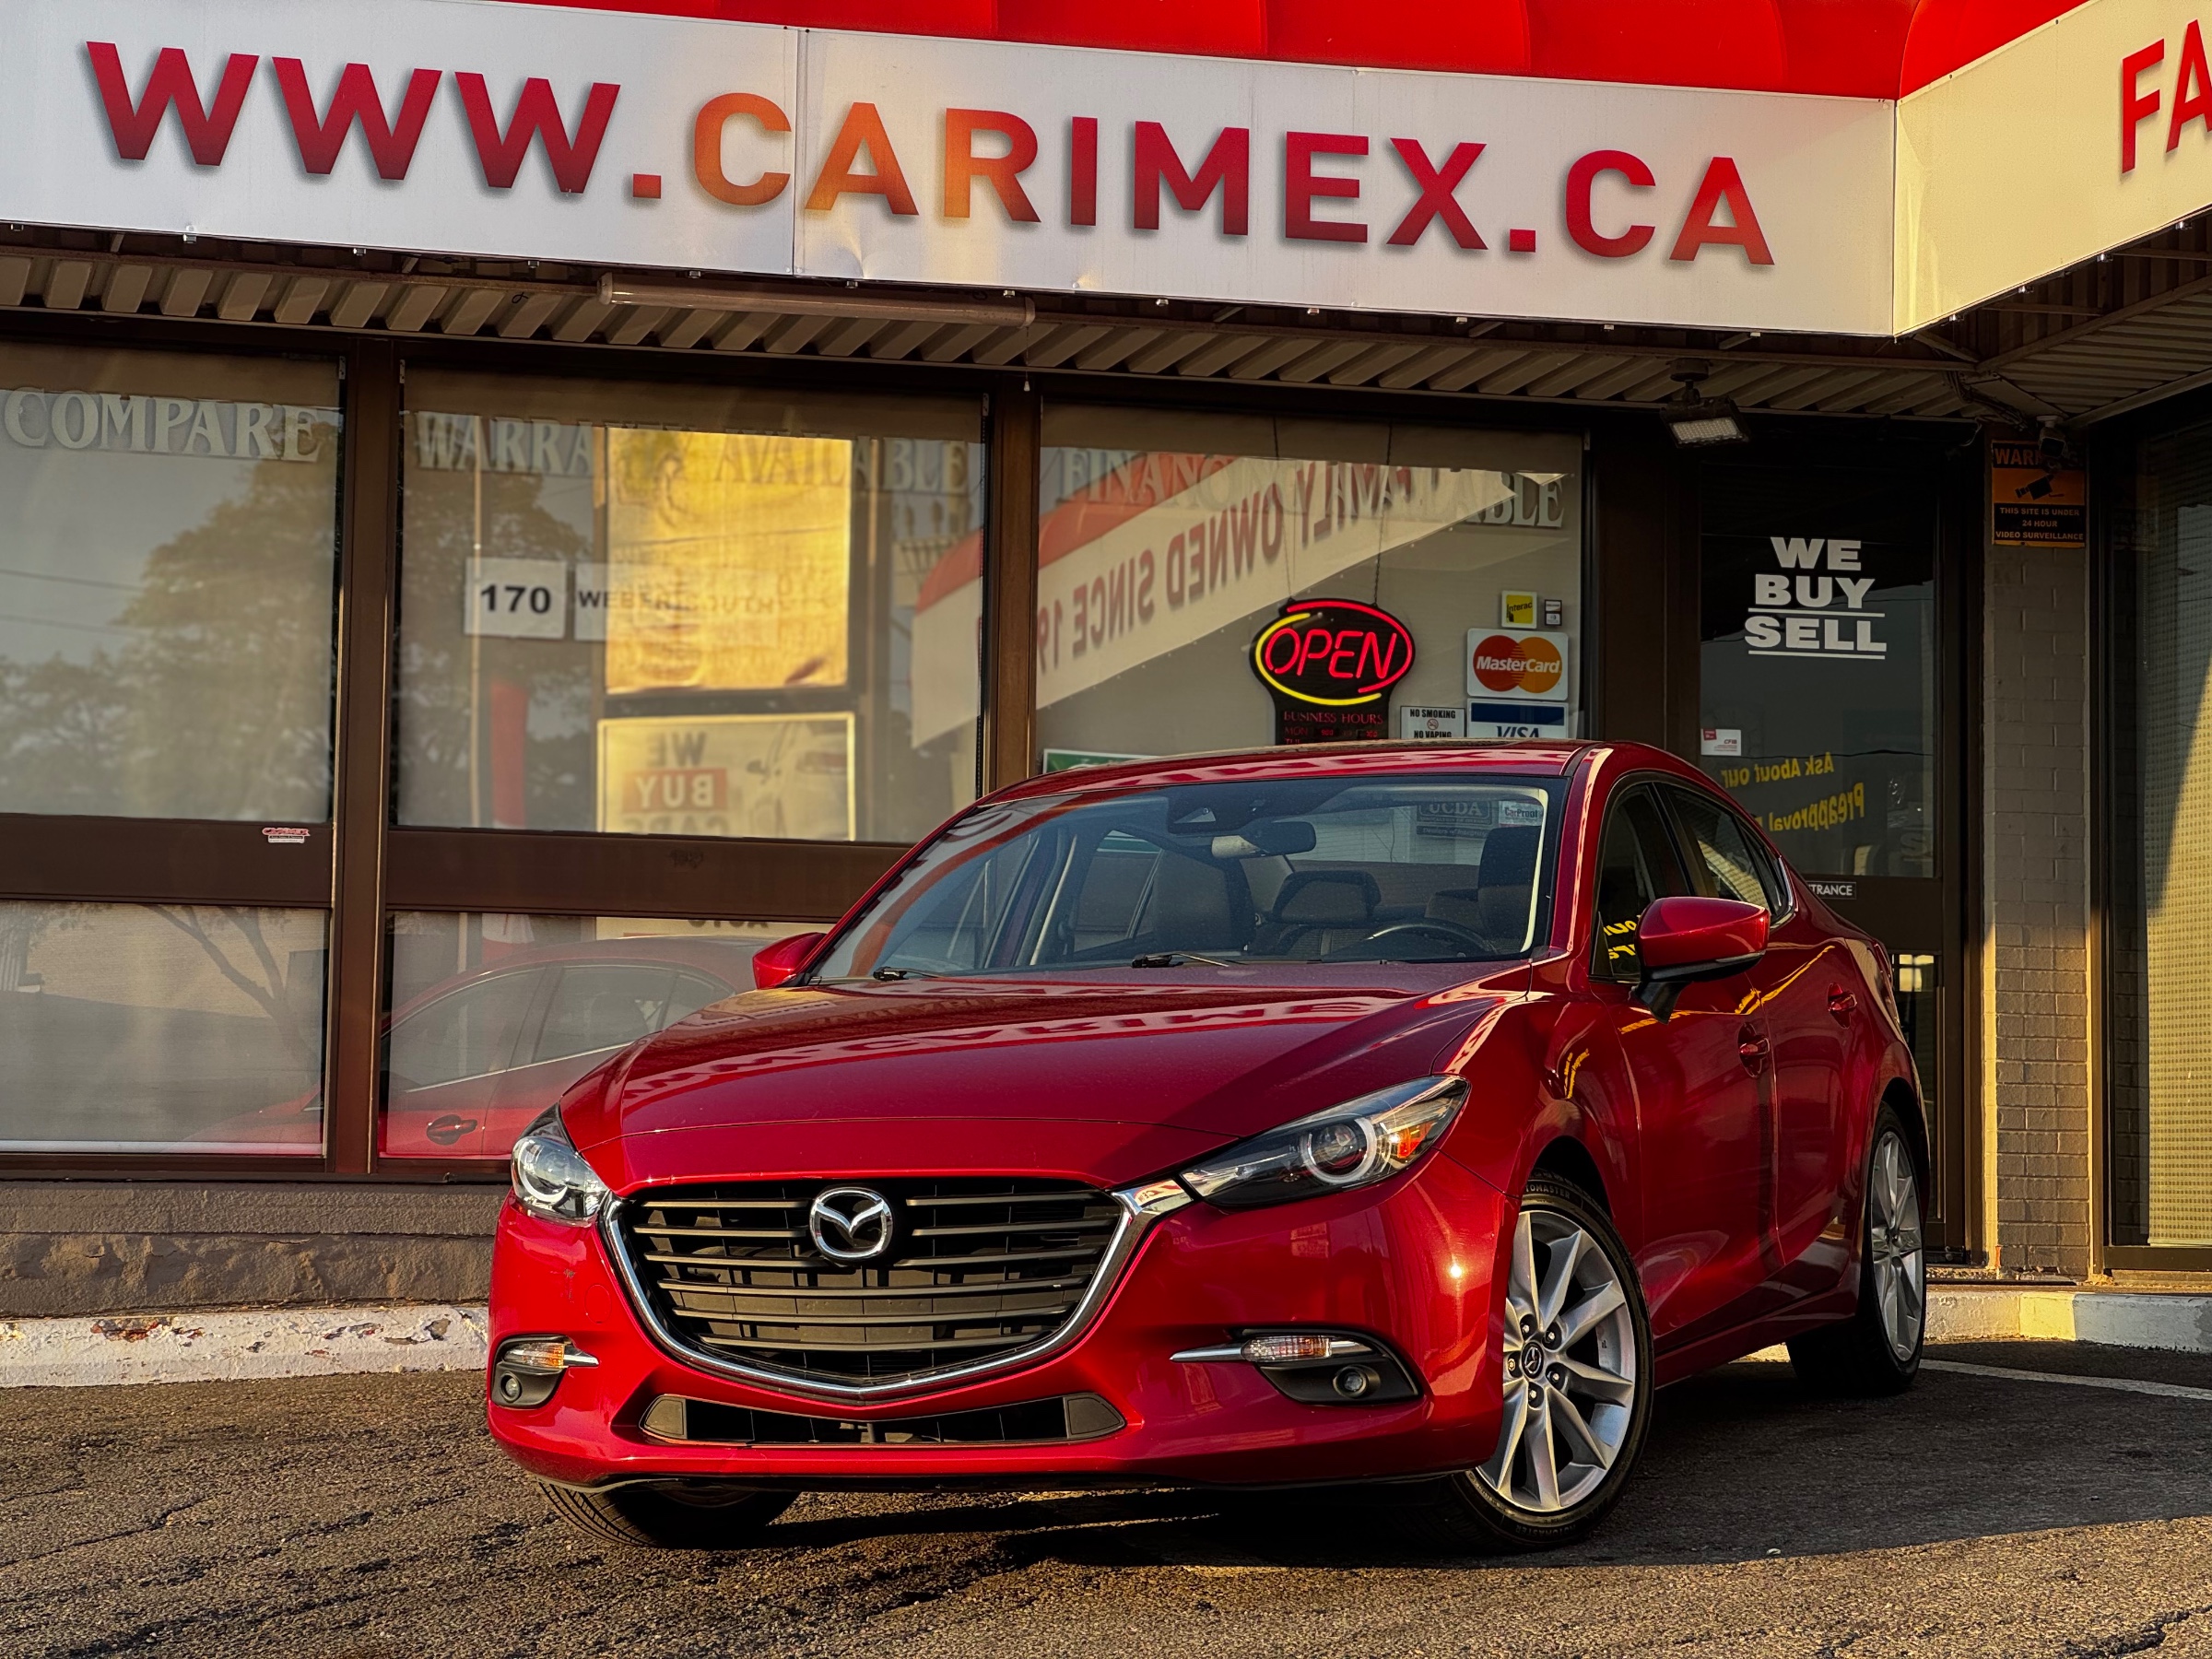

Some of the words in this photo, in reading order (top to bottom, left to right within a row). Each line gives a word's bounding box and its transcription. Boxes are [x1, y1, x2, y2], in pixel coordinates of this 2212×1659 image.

[86, 41, 1775, 266] WWW.CARIMEX.CA
[4, 387, 323, 462] COMPARE
[417, 411, 697, 486] WARRA
[2022, 532, 2084, 540] SURVEILLANCE
[1770, 536, 1861, 571] WE
[1755, 573, 1875, 608] BUY
[479, 584, 551, 615] 170
[1506, 602, 1533, 613] Interac
[1745, 616, 1887, 652] SELL
[1265, 628, 1395, 679] OPEN
[1477, 656, 1560, 674] MasterCard
[1284, 711, 1336, 724] BUSINESS
[1342, 713, 1383, 724] HOURS
[1410, 708, 1420, 718] NO
[1422, 709, 1455, 718] SMOKING
[1285, 726, 1308, 736] MON
[1414, 730, 1424, 738] NO
[1497, 725, 1540, 738] VISA
[1428, 801, 1483, 817] UCDA
[1808, 884, 1853, 897] TRANCE
[1525, 1183, 1571, 1199] TOMASTER
